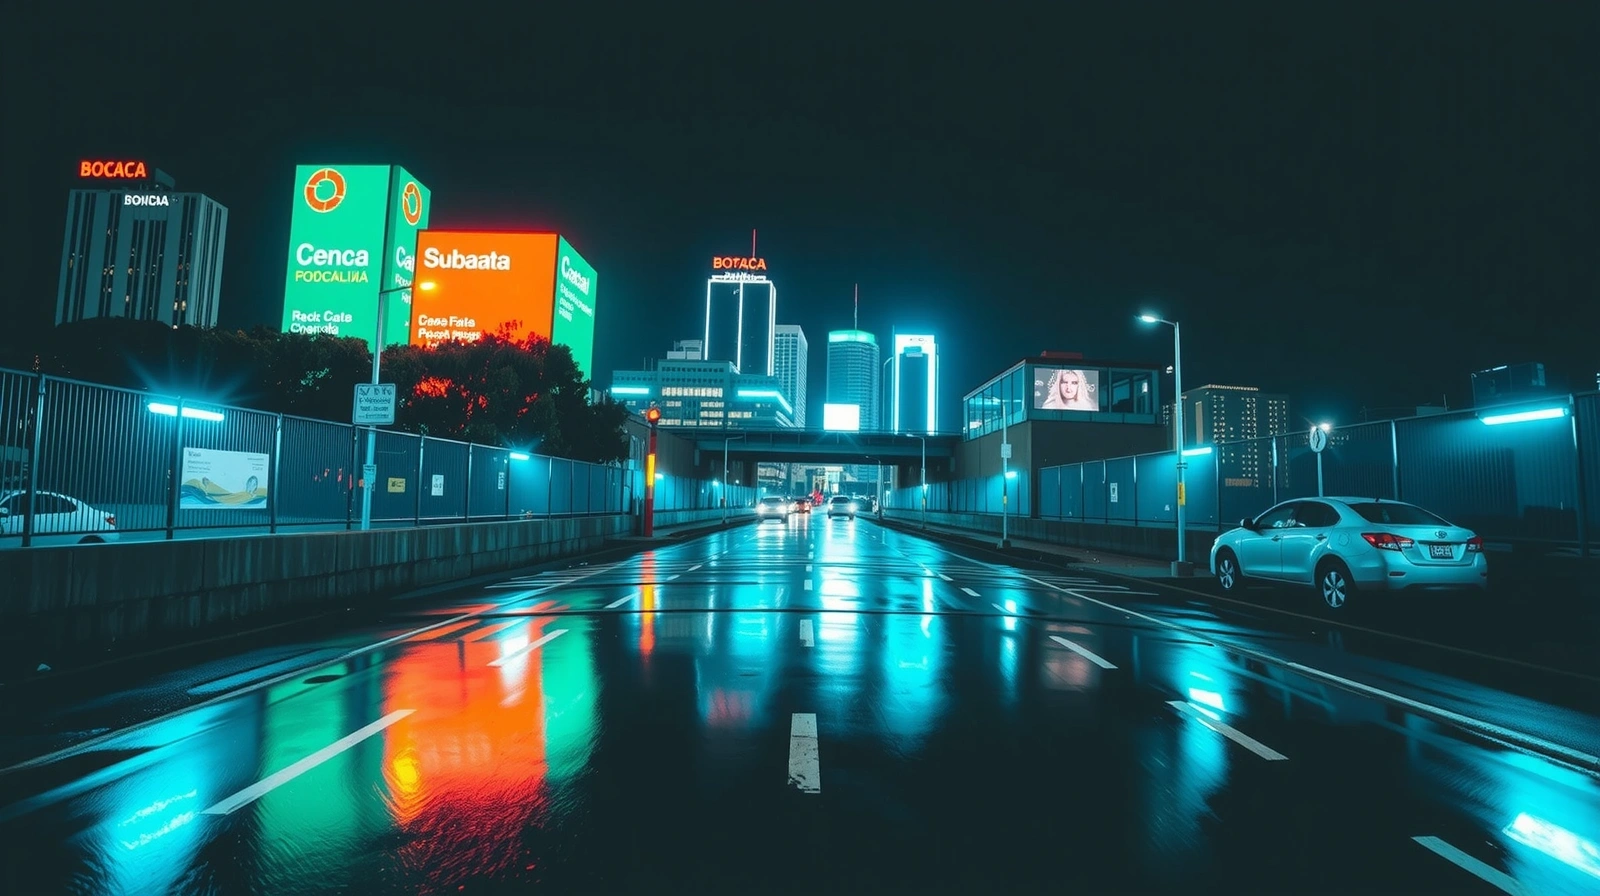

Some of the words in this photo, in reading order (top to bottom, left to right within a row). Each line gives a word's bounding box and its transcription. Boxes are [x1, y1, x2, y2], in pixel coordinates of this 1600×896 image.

[81, 161, 147, 178] BOCACA
[296, 243, 369, 267] Cenca
[423, 247, 511, 271] Subaata
[713, 256, 767, 270] BOTACA
